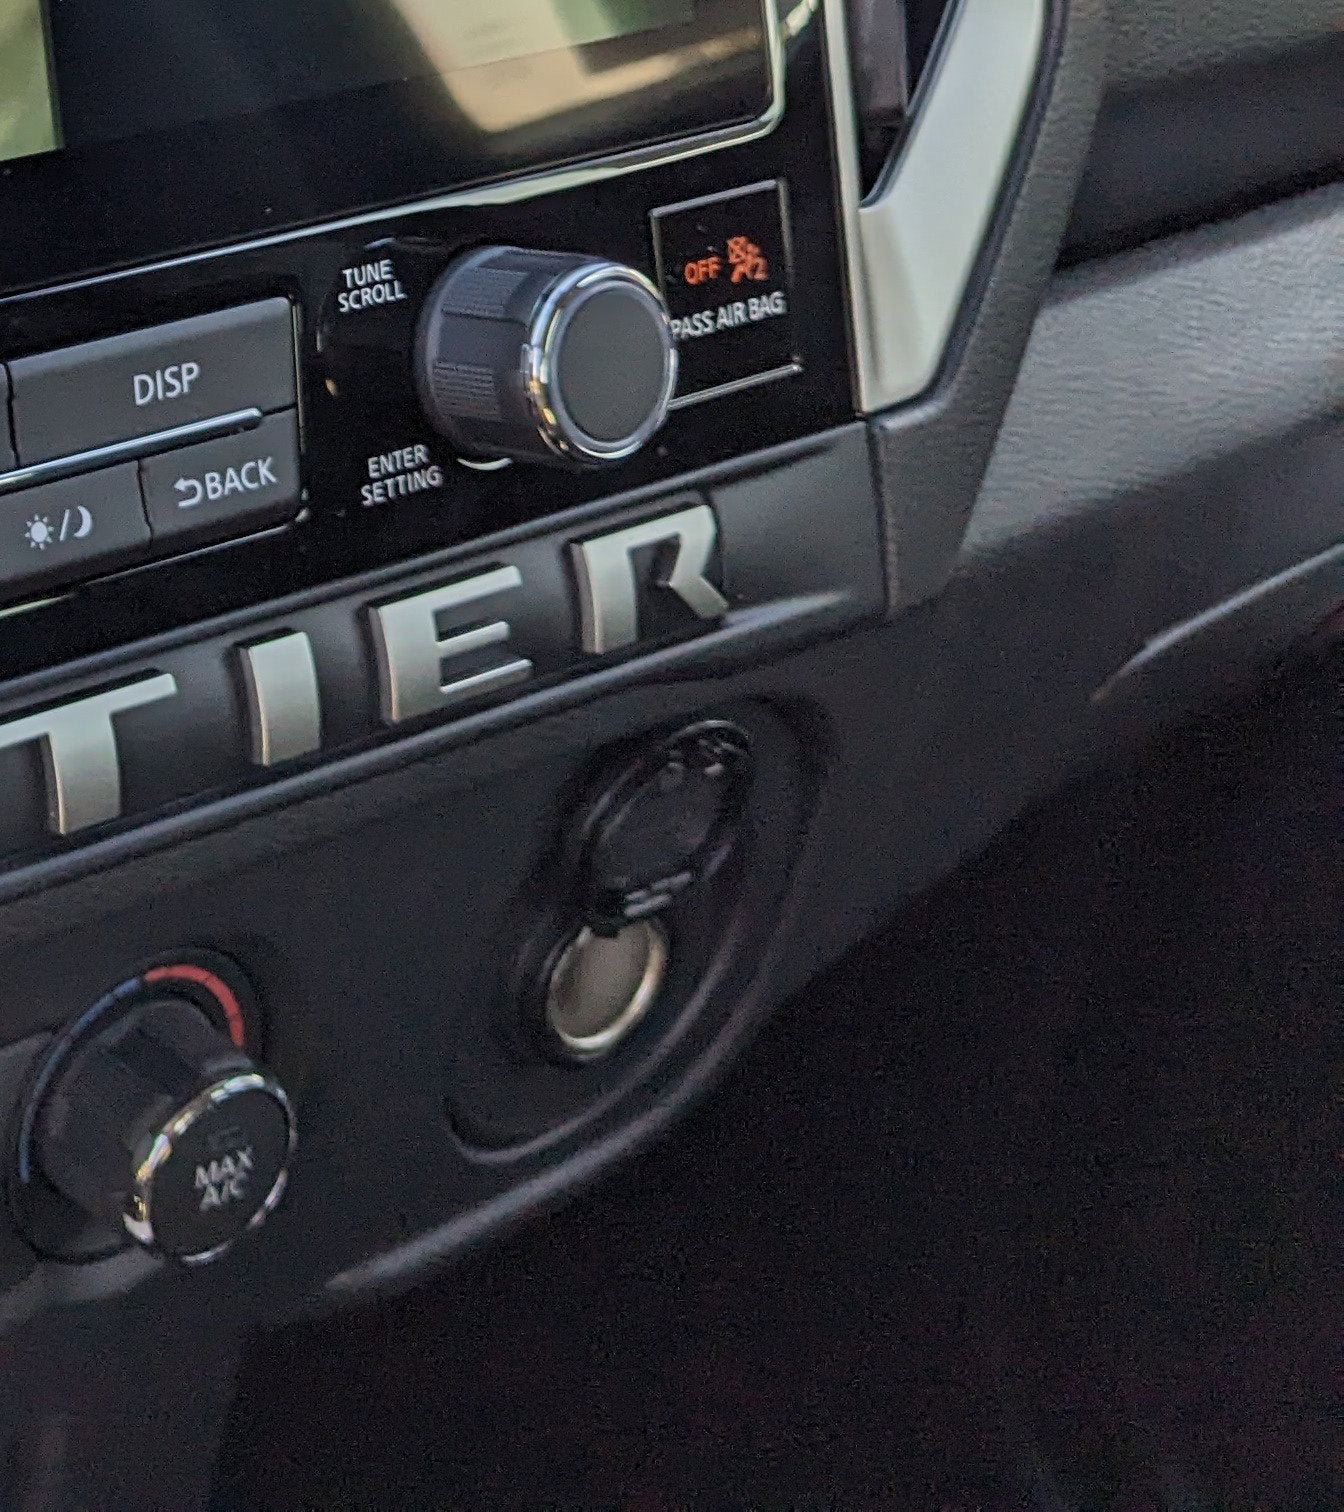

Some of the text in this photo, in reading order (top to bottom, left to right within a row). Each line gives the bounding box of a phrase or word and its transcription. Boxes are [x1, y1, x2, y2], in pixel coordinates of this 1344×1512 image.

[342, 258, 394, 284] TUNE
[683, 256, 720, 285] OFF
[337, 281, 407, 314] SCROLL
[669, 290, 788, 341] PASS AIR BAG
[134, 361, 200, 407] DISP
[206, 456, 277, 502] BACK
[367, 444, 429, 480] ENTER
[361, 466, 443, 507] SETTING
